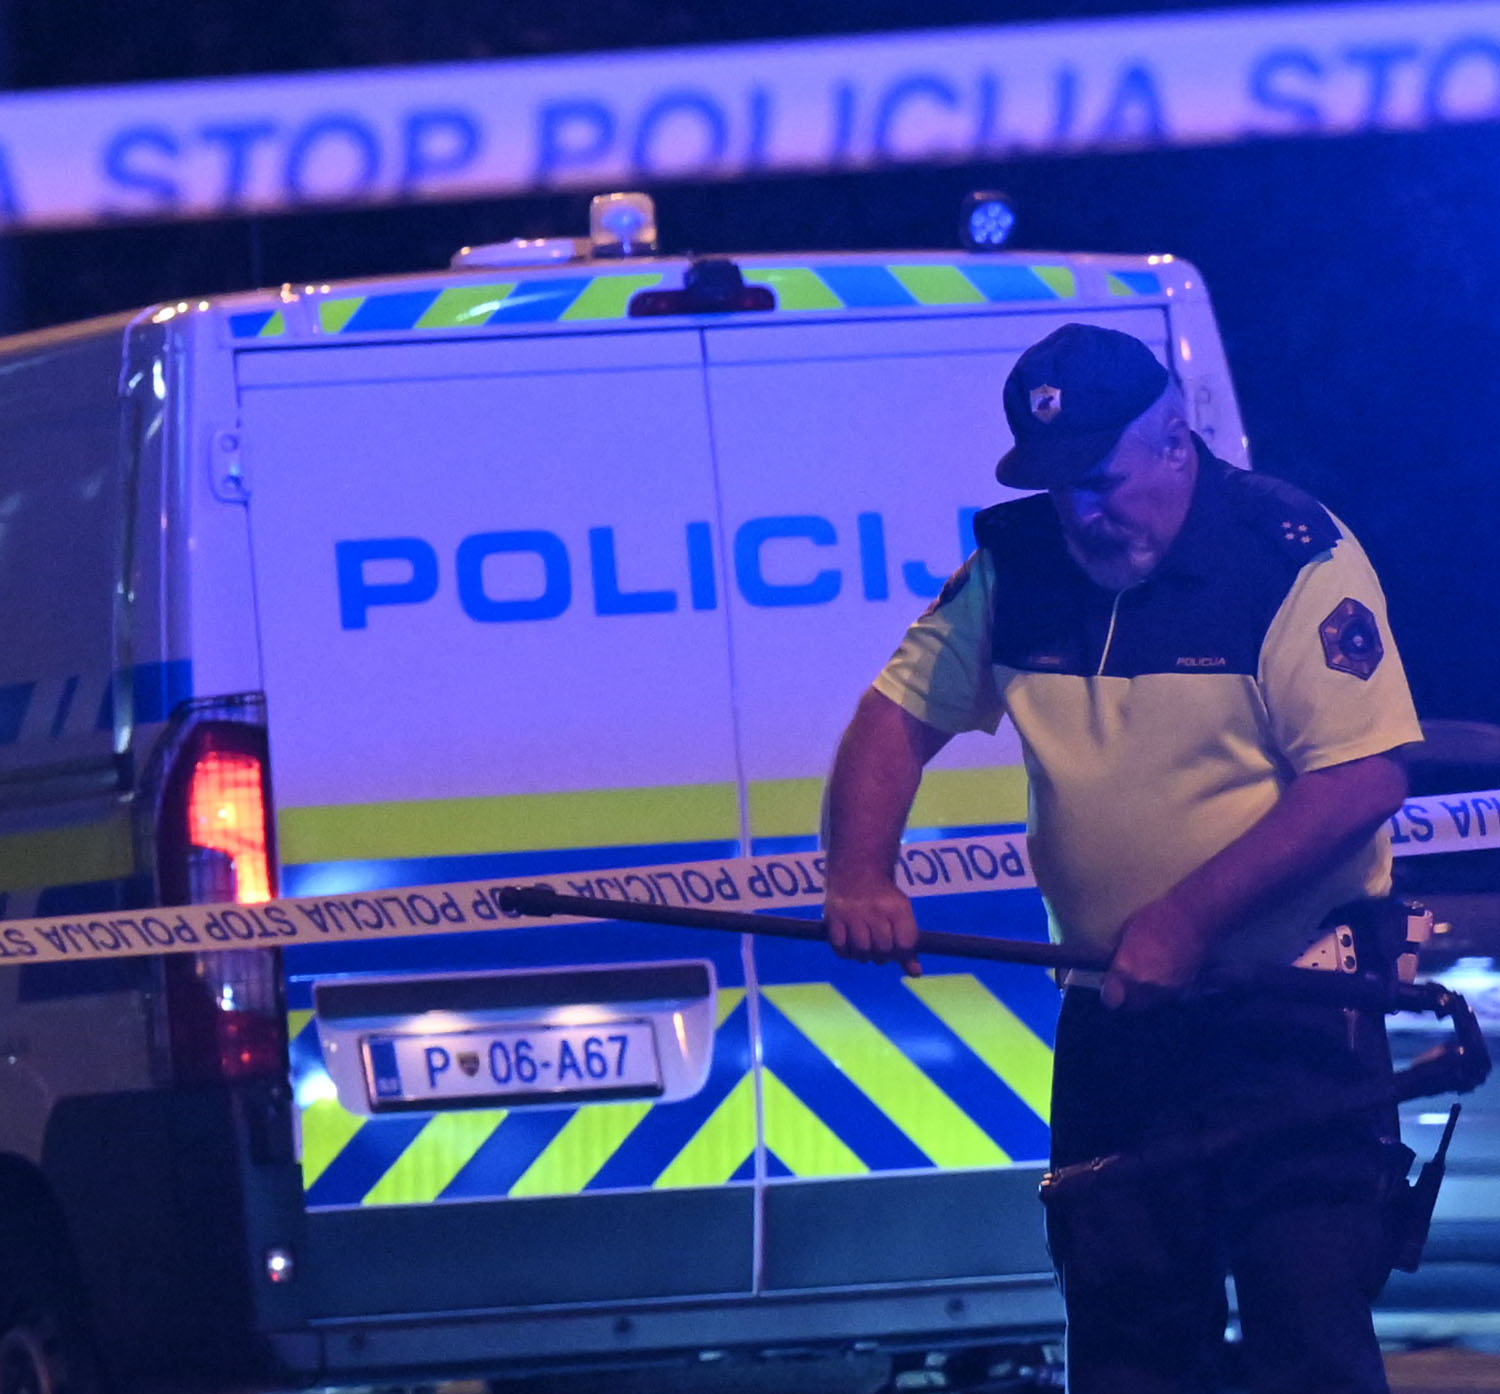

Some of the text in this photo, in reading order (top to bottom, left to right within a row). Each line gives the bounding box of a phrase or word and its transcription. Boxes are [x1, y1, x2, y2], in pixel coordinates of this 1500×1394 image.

[96, 107, 481, 219] STOP
[533, 56, 1171, 183] POLICIJA
[1246, 34, 1500, 133] STO
[335, 505, 984, 631] POLICIJ
[1390, 804, 1434, 844] ST
[899, 841, 1025, 886] POLICI
[204, 905, 298, 941] STOP
[296, 891, 466, 933] POLICIJA
[34, 914, 200, 954] POLICIJA
[423, 1035, 629, 1089] P 06-A67
